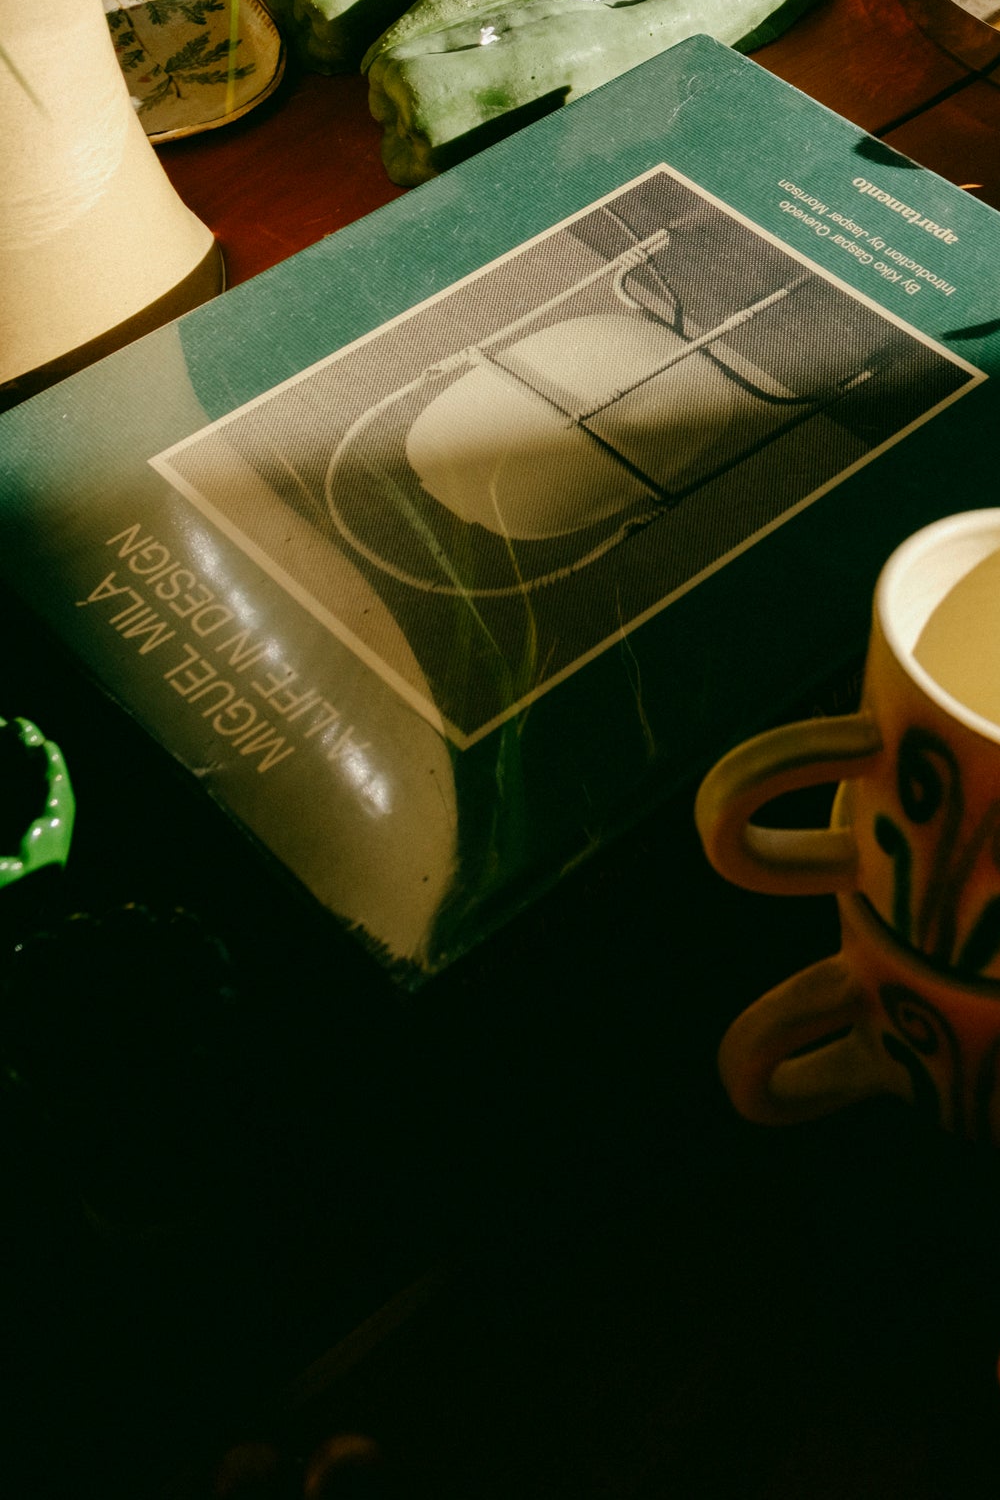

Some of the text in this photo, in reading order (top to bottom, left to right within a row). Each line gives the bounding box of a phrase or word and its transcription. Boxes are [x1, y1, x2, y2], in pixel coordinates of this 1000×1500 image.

[777, 179, 957, 297] Introduction by Jasper Morrison
[779, 200, 922, 296] By Kiko Gaspar Quevedo
[852, 177, 959, 245] apartamento
[75, 571, 296, 774] MIGUEL MILÁ
[105, 522, 372, 761] A LIFE IN DESIGN
